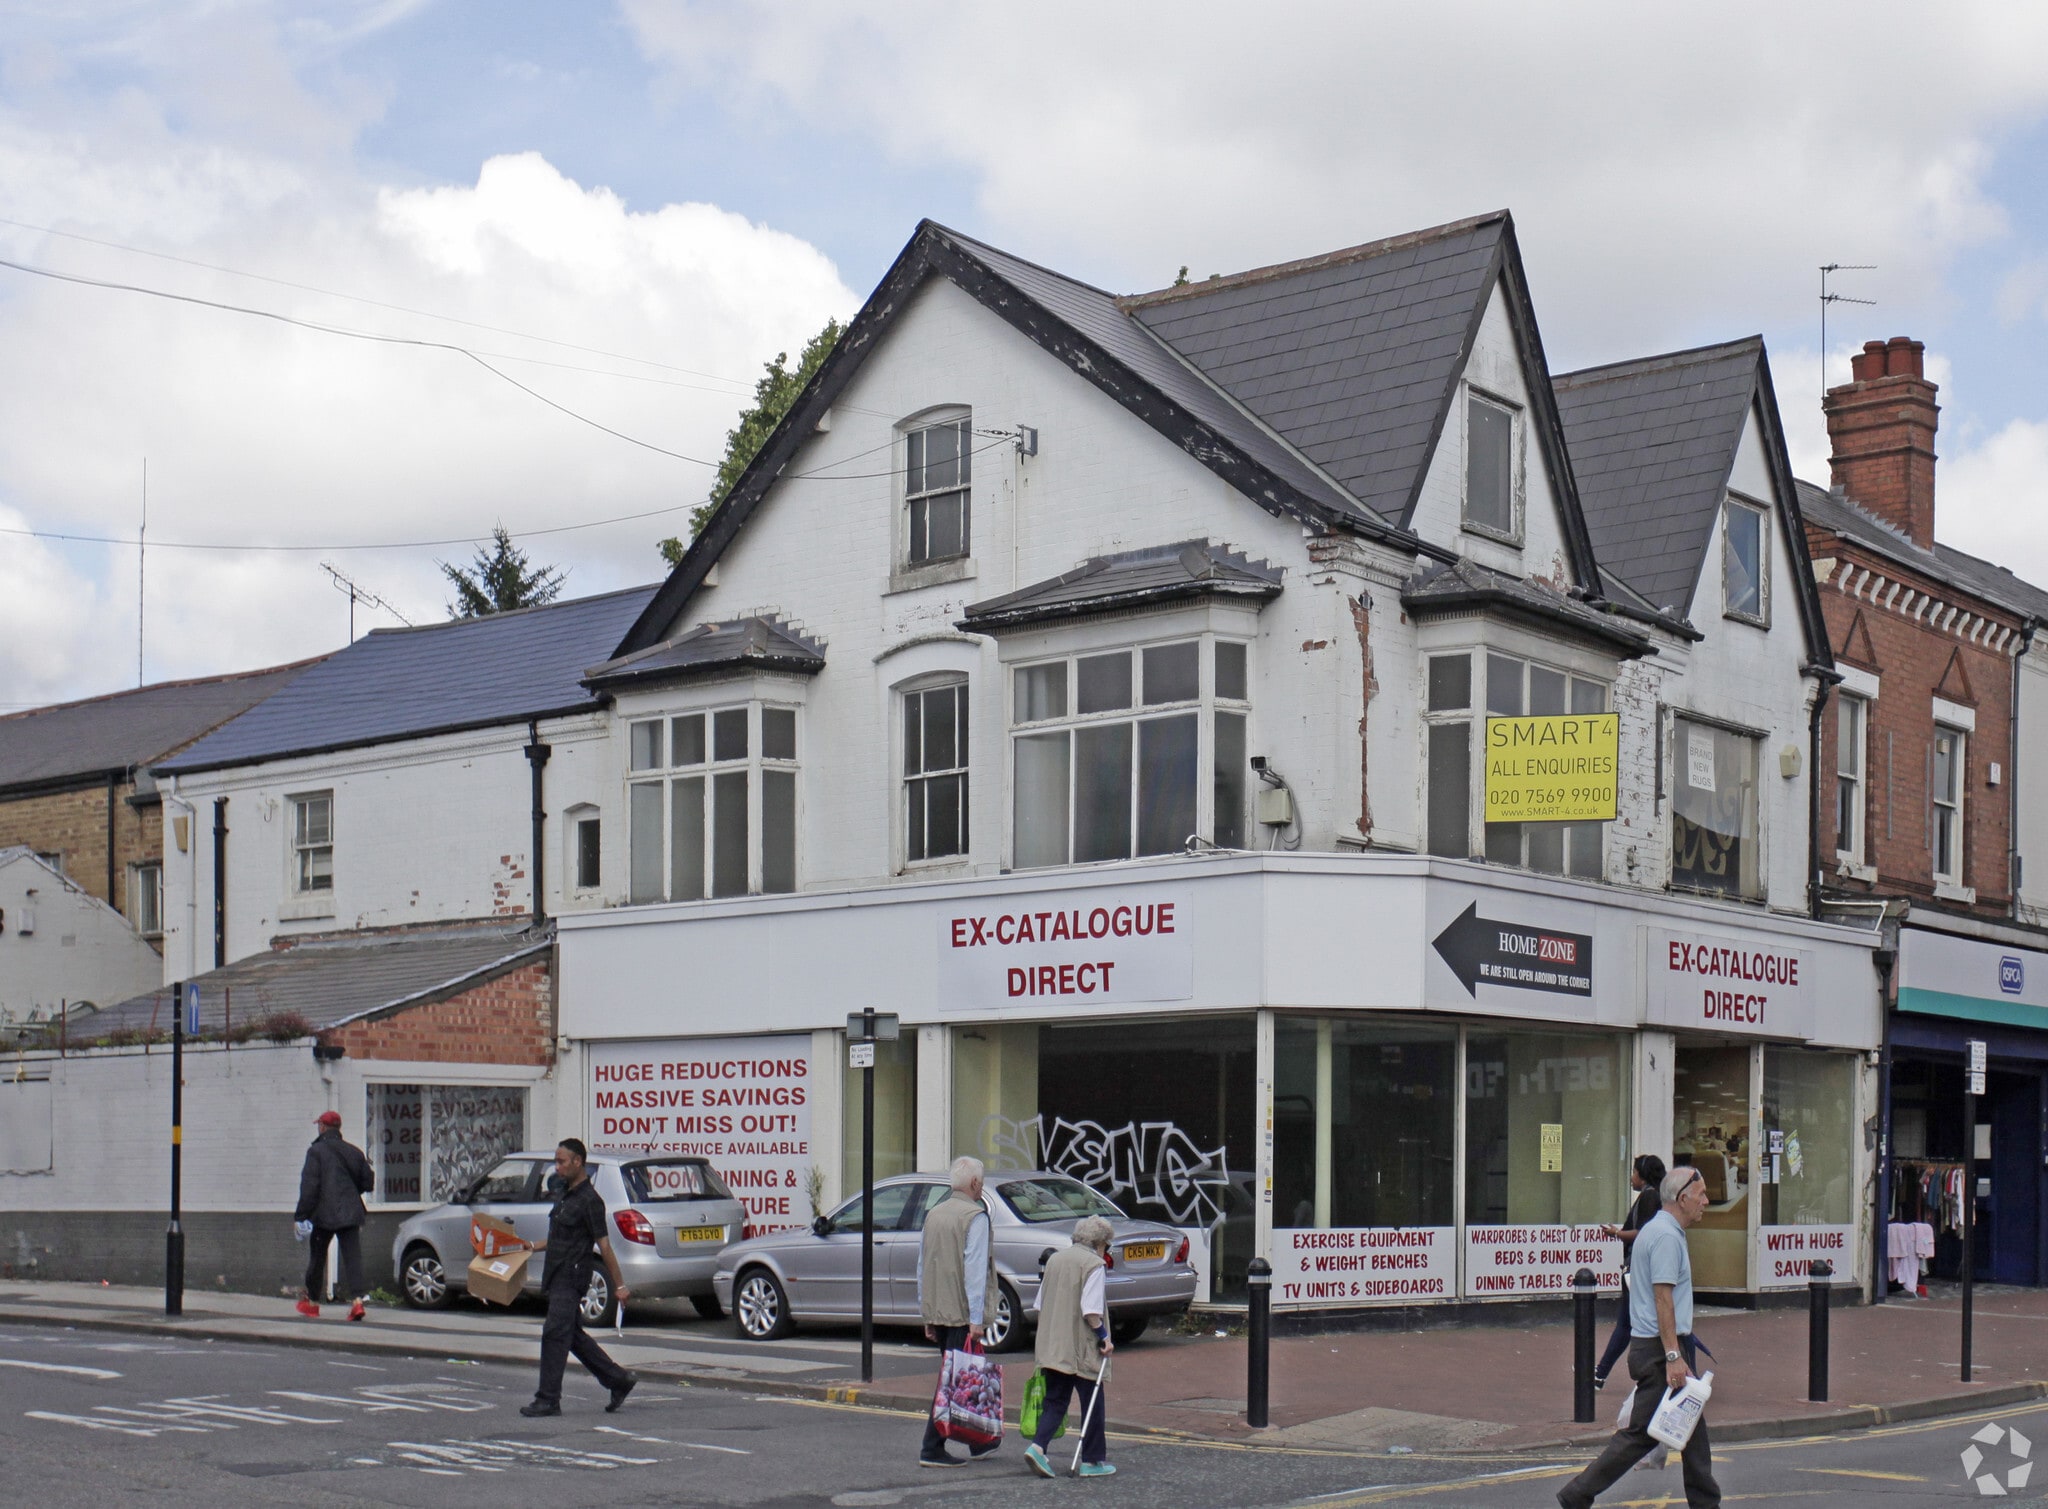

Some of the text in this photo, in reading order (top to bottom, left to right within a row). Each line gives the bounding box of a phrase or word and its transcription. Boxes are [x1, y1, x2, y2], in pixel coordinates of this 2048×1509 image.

[1689, 746, 1713, 761] BRAND
[1492, 756, 1612, 776] ALL ENQUIRIES
[1693, 761, 1710, 773] NEW
[1692, 774, 1712, 787] RUGS
[1490, 787, 1611, 804] 020 7569 9900
[1501, 806, 1598, 816] www.SMART-4.co.uk
[951, 903, 1175, 948] EX-CATALOGUE
[1498, 931, 1575, 961] HOME ZONE
[1669, 941, 1798, 986] EX-CATALOGUE
[1007, 962, 1115, 997] DIRECT
[1480, 963, 1590, 990] WE ARE STILL OPEN AROUND THE CORNER
[2002, 966, 2022, 984] RSPCA
[1704, 989, 1767, 1024] DIRECT
[595, 1059, 808, 1082] HUGE REDUCTIONS
[596, 1087, 806, 1109] MASSIVE SAVINGS
[603, 1115, 797, 1134] DON'T MISS OUT!
[1542, 1135, 1561, 1143] FAIR
[663, 1142, 723, 1155] SERVICE
[727, 1142, 808, 1155] AVAILABLE
[718, 1169, 778, 1188] INING
[785, 1169, 798, 1188] &
[681, 1229, 704, 1241] FT63
[1293, 1231, 1435, 1249] EXERCISE EQUIPMENT
[1471, 1229, 1528, 1244] WARDROBES
[1530, 1229, 1537, 1243] &
[1540, 1229, 1567, 1243] CHEST
[1570, 1229, 1581, 1243] OF
[1767, 1232, 1844, 1251] WITH HUGE
[1127, 1246, 1161, 1259] CK51 MKX
[1495, 1249, 1603, 1265] BEDS & BUNK BEDS
[1300, 1253, 1428, 1272] & WEIGHT BENCHES
[1283, 1278, 1444, 1298] TV UNITS & SIDEBOARDS
[1476, 1275, 1515, 1291] DINING
[1519, 1274, 1562, 1289] TABLES
[1566, 1274, 1575, 1287] &
